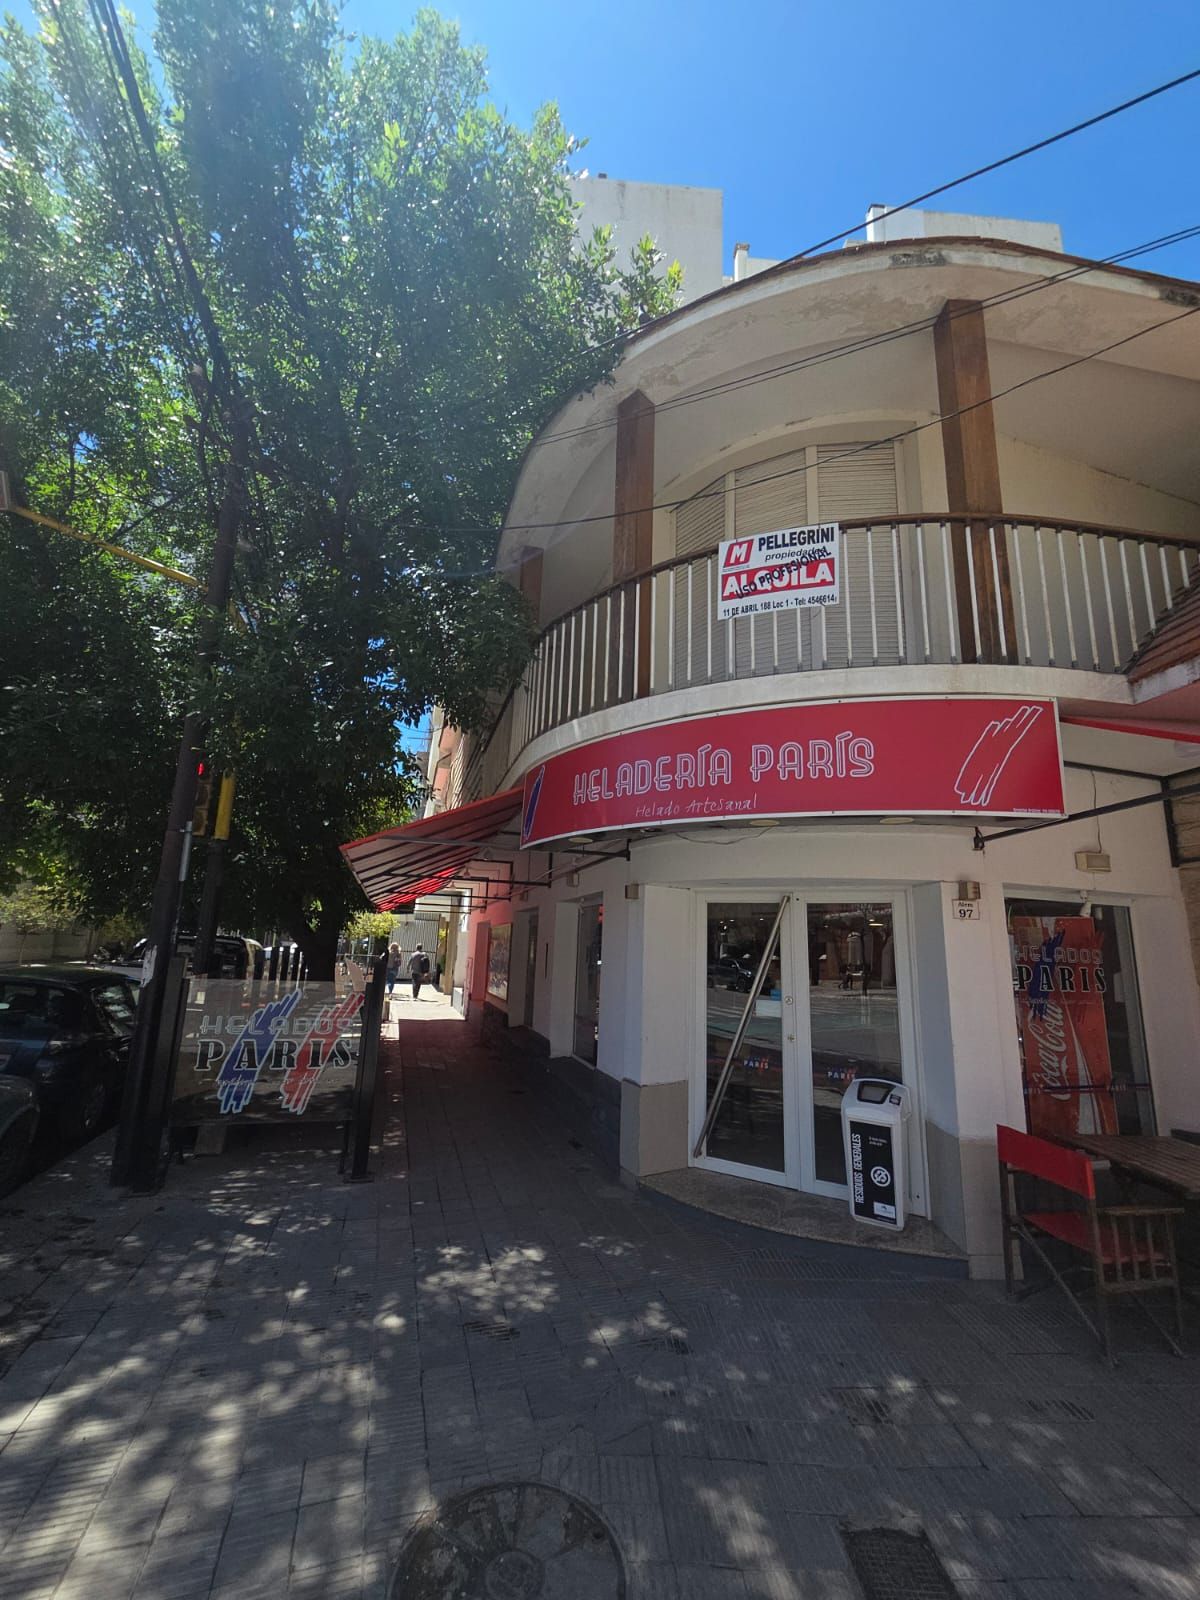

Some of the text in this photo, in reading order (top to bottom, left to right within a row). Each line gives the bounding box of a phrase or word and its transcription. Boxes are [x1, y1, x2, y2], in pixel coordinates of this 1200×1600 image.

[758, 526, 835, 552] PELLEGRINI
[722, 562, 834, 597] ALQUILA
[735, 546, 832, 599] USO PROFESIONAL
[731, 606, 740, 616] DE
[740, 604, 759, 614] ABRIL
[772, 600, 784, 609] Loc
[571, 730, 875, 806] HELADERÍA PARÍS
[635, 792, 758, 818] Helado Artesanal
[958, 909, 973, 918] 97
[1014, 945, 1104, 965] HELADOS
[1014, 964, 1107, 993] PARIS
[199, 1015, 354, 1035] HELADOS
[193, 1038, 354, 1071] PARIS
[851, 1132, 863, 1171] GENERALES
